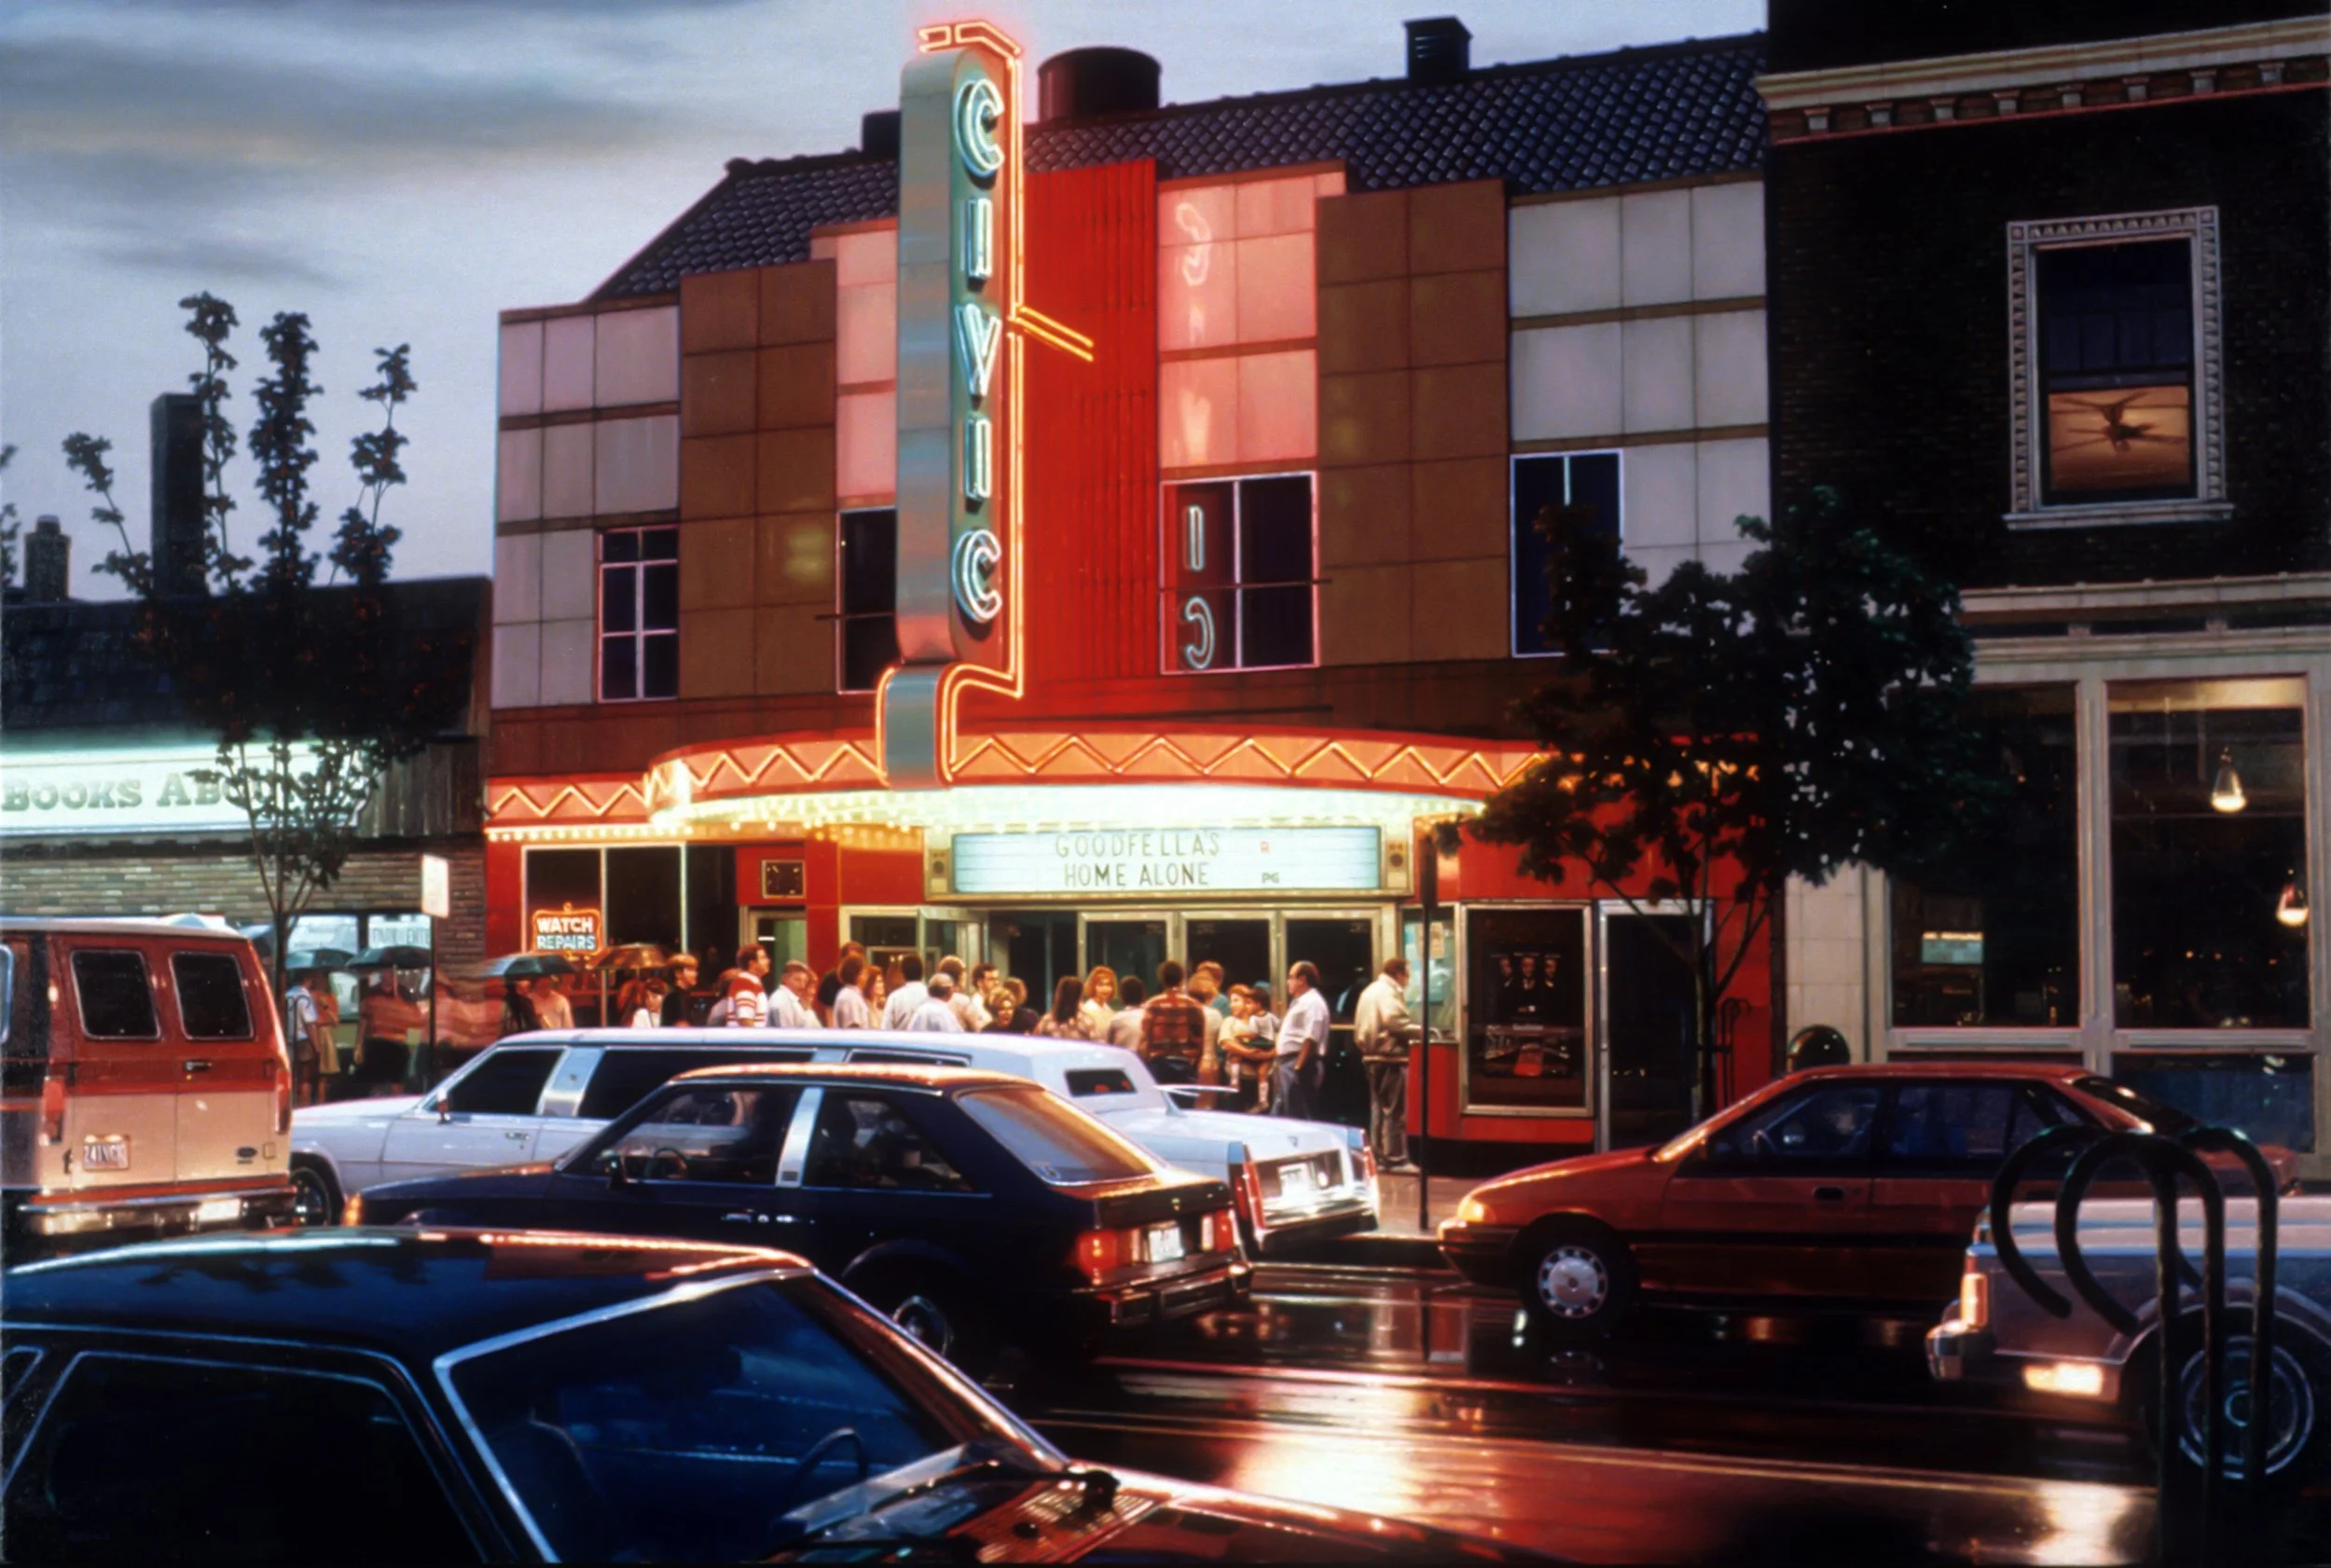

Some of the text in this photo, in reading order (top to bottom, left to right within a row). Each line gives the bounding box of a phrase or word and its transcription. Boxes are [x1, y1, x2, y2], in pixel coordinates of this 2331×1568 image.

[954, 77, 1004, 624] CIVIC
[2, 778, 143, 811] BOOKS
[1065, 861, 1280, 887] HOME ALONE PG
[537, 917, 593, 933] WATCH
[537, 935, 596, 950] REPAIRS
